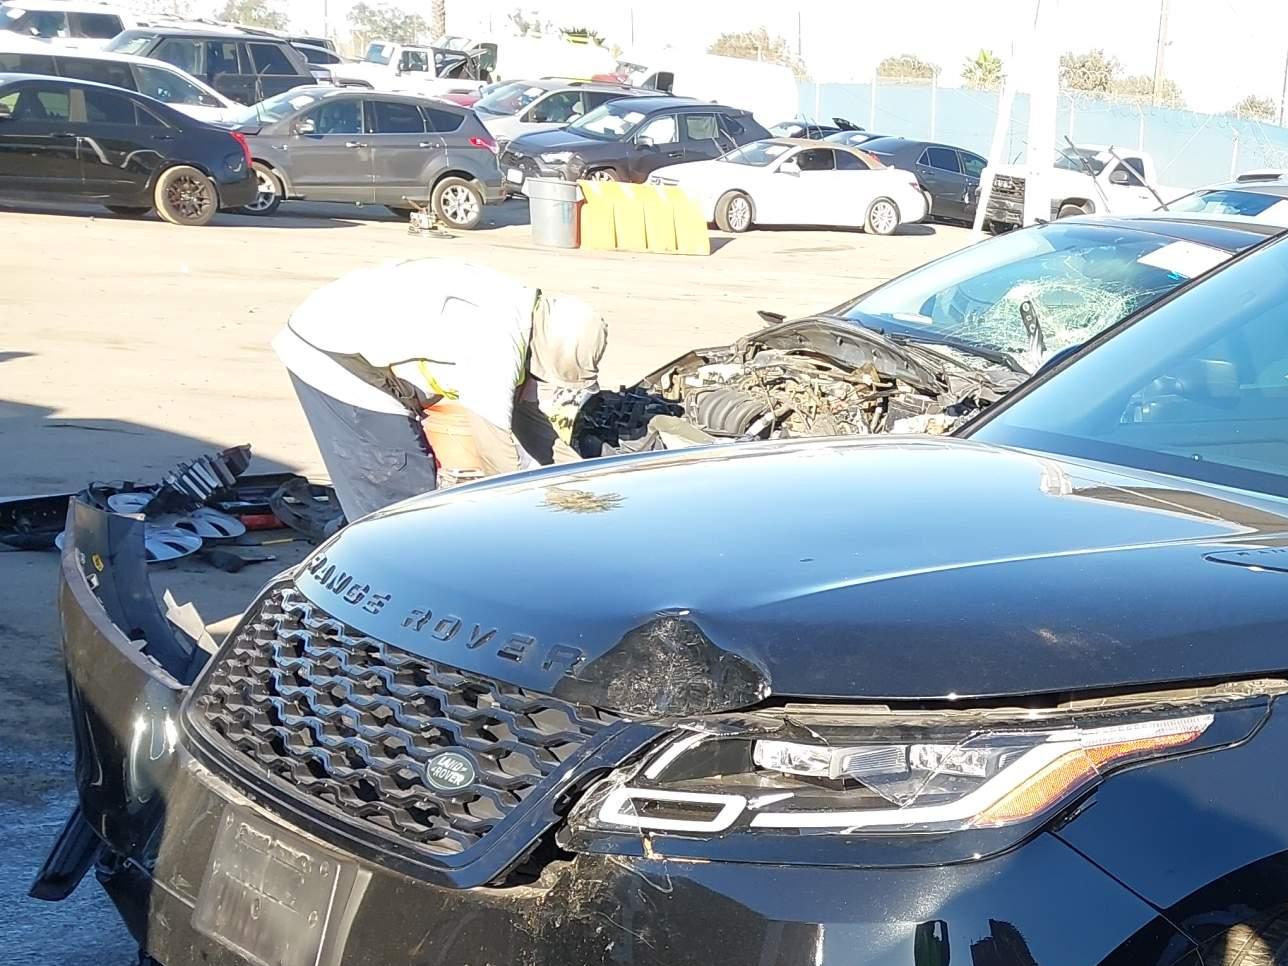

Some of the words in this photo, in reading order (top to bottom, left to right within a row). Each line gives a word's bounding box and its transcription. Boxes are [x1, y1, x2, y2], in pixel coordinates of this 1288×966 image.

[307, 554, 392, 615] RANGE
[401, 608, 588, 677] ROVER
[437, 756, 463, 772] LAND
[433, 766, 465, 786] ROVER
